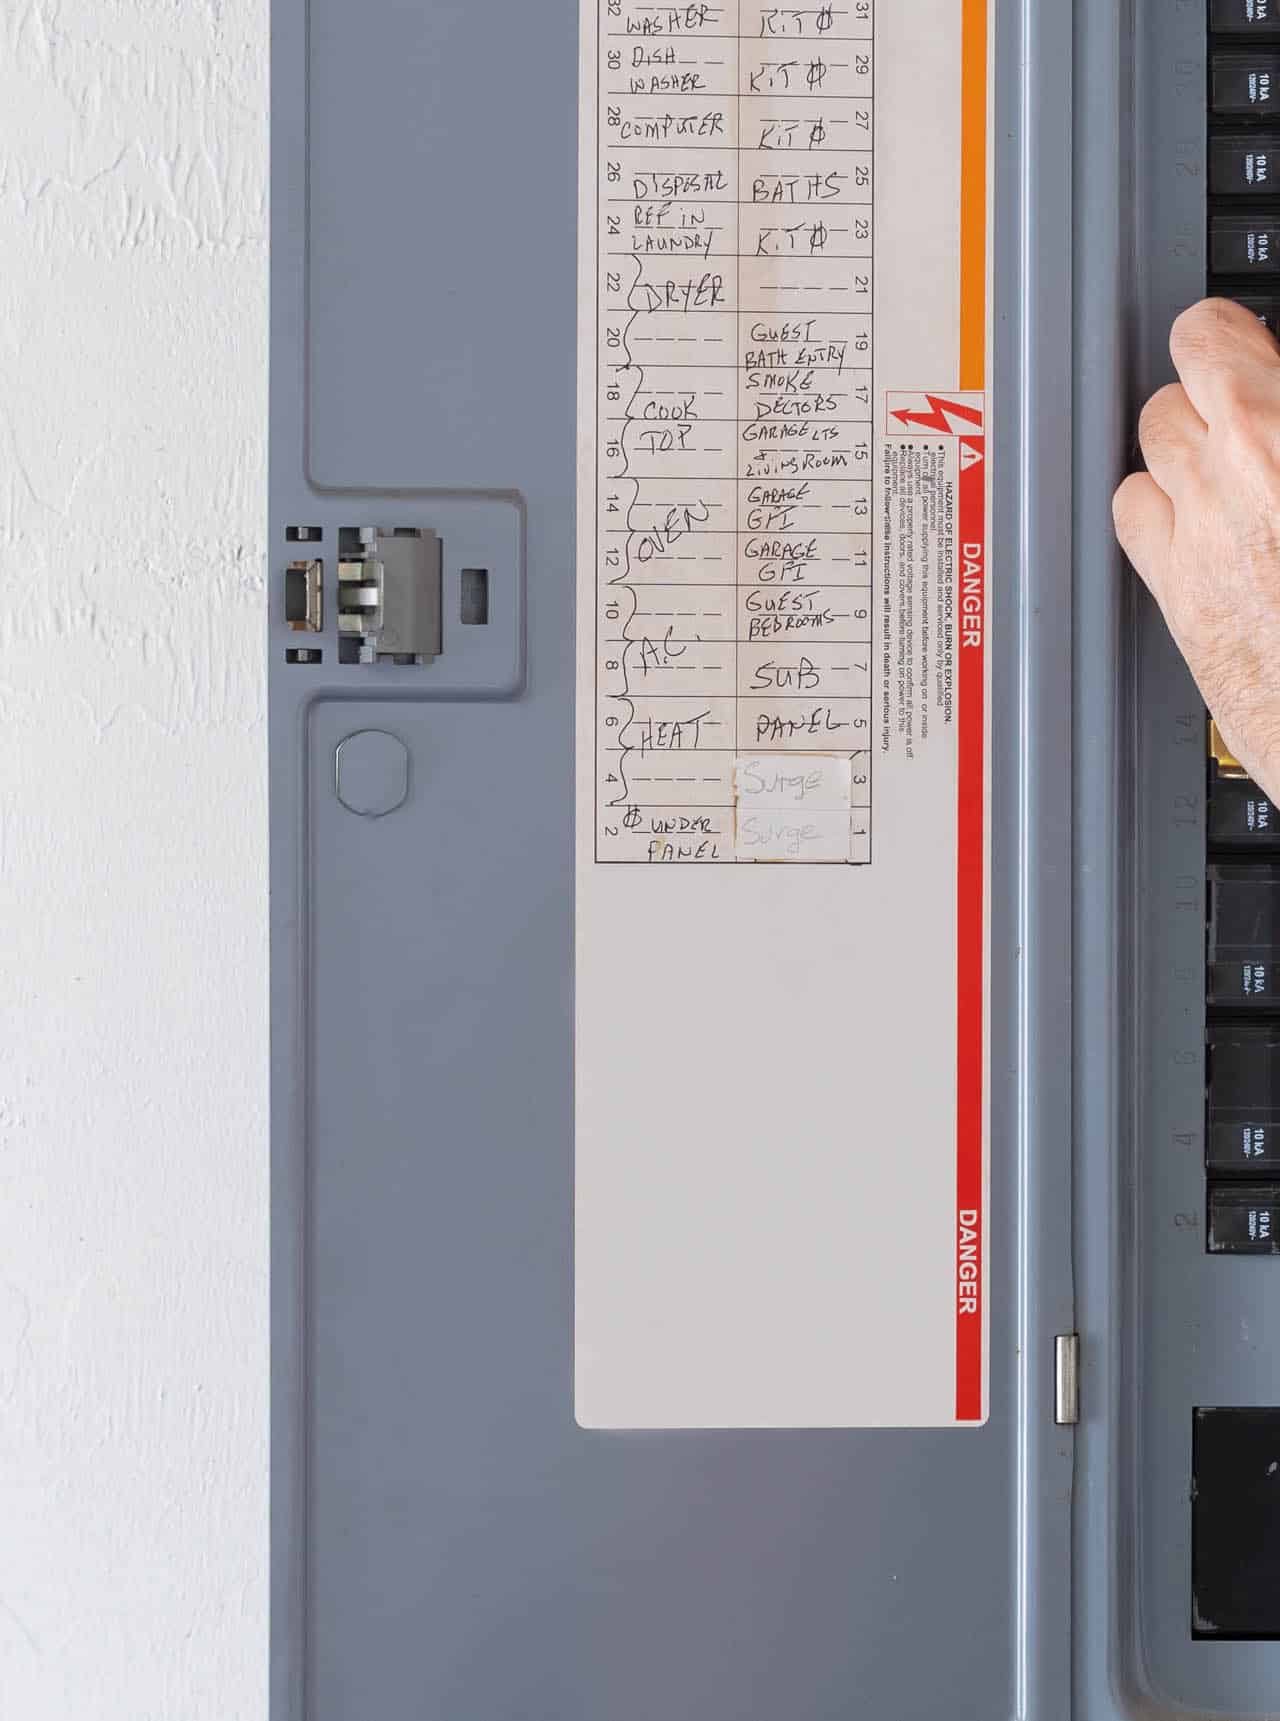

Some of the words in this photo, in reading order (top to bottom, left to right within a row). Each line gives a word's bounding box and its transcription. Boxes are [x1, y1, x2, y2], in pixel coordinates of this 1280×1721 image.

[627, 4, 719, 35] WASHER
[856, 3, 869, 19] 31
[608, 51, 620, 69] 30
[631, 46, 676, 68] DISH
[856, 56, 869, 74] 29
[630, 73, 706, 94] WASHER
[608, 107, 620, 126] 28
[620, 112, 724, 139] COMPUTER
[856, 111, 868, 130] 27
[608, 162, 620, 181] 26
[856, 167, 868, 185] 25
[752, 171, 840, 203] BATHS
[608, 216, 620, 234] 24
[856, 220, 868, 239] 23
[631, 231, 713, 260] LAUNDRY
[607, 273, 620, 291] 22
[856, 276, 868, 293] 21
[645, 272, 725, 313] DRYER
[607, 328, 620, 347] 20
[750, 319, 816, 341] GUEST
[856, 333, 868, 350] 19
[745, 347, 788, 372] BATH
[745, 370, 814, 392] SMOKE
[607, 384, 619, 400] 18
[856, 386, 868, 403] 17
[643, 395, 698, 420] COOK
[639, 423, 692, 455] TOP
[742, 420, 809, 441] GARAGE
[812, 427, 840, 440] LTS
[607, 438, 619, 457] 16
[855, 443, 868, 459] 15
[747, 482, 811, 505] GARAGE
[944, 481, 953, 520] HAZARD
[607, 495, 619, 512] 14
[855, 498, 867, 515] 13
[638, 499, 709, 562] OVEN
[944, 522, 953, 535] OF
[606, 548, 619, 566] 12
[744, 537, 817, 560] GARAGE
[855, 550, 867, 565] 11
[944, 537, 953, 583] ELECTRIC
[745, 590, 820, 611] GUEST
[962, 543, 981, 648] DANGER
[606, 601, 619, 619] 10
[855, 610, 867, 618] 9
[749, 608, 835, 641] BEDROOMS
[944, 624, 953, 650] BURN
[606, 661, 618, 669] 8
[944, 652, 953, 666] OR
[749, 657, 820, 689] SUB
[606, 717, 618, 726] 6
[756, 707, 842, 743] PANEL
[854, 719, 866, 728] 5
[640, 709, 711, 759] HEAT
[606, 771, 618, 782] 4
[854, 776, 866, 784] 3
[605, 827, 618, 835] 2
[651, 816, 712, 833] UNDER
[959, 1209, 977, 1314] DANGER
